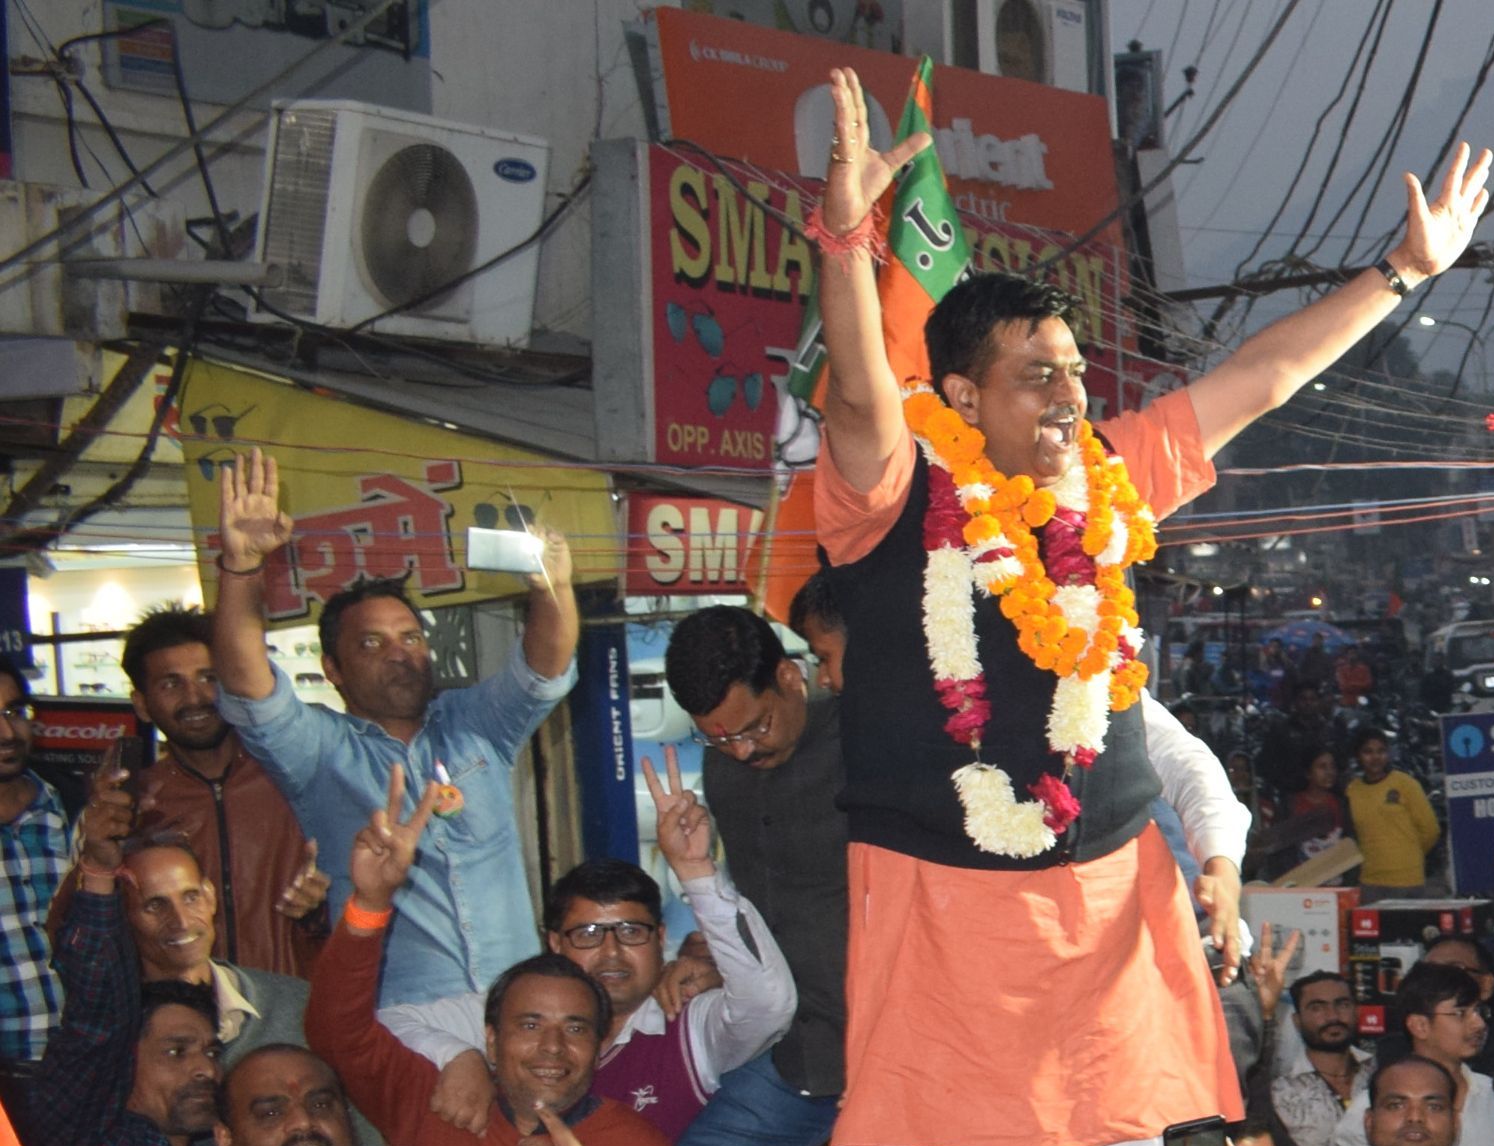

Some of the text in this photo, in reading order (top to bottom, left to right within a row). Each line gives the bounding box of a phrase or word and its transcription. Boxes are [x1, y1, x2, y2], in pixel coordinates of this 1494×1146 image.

[719, 428, 765, 459] AXIS
[607, 647, 626, 781] ORIENT FANS
